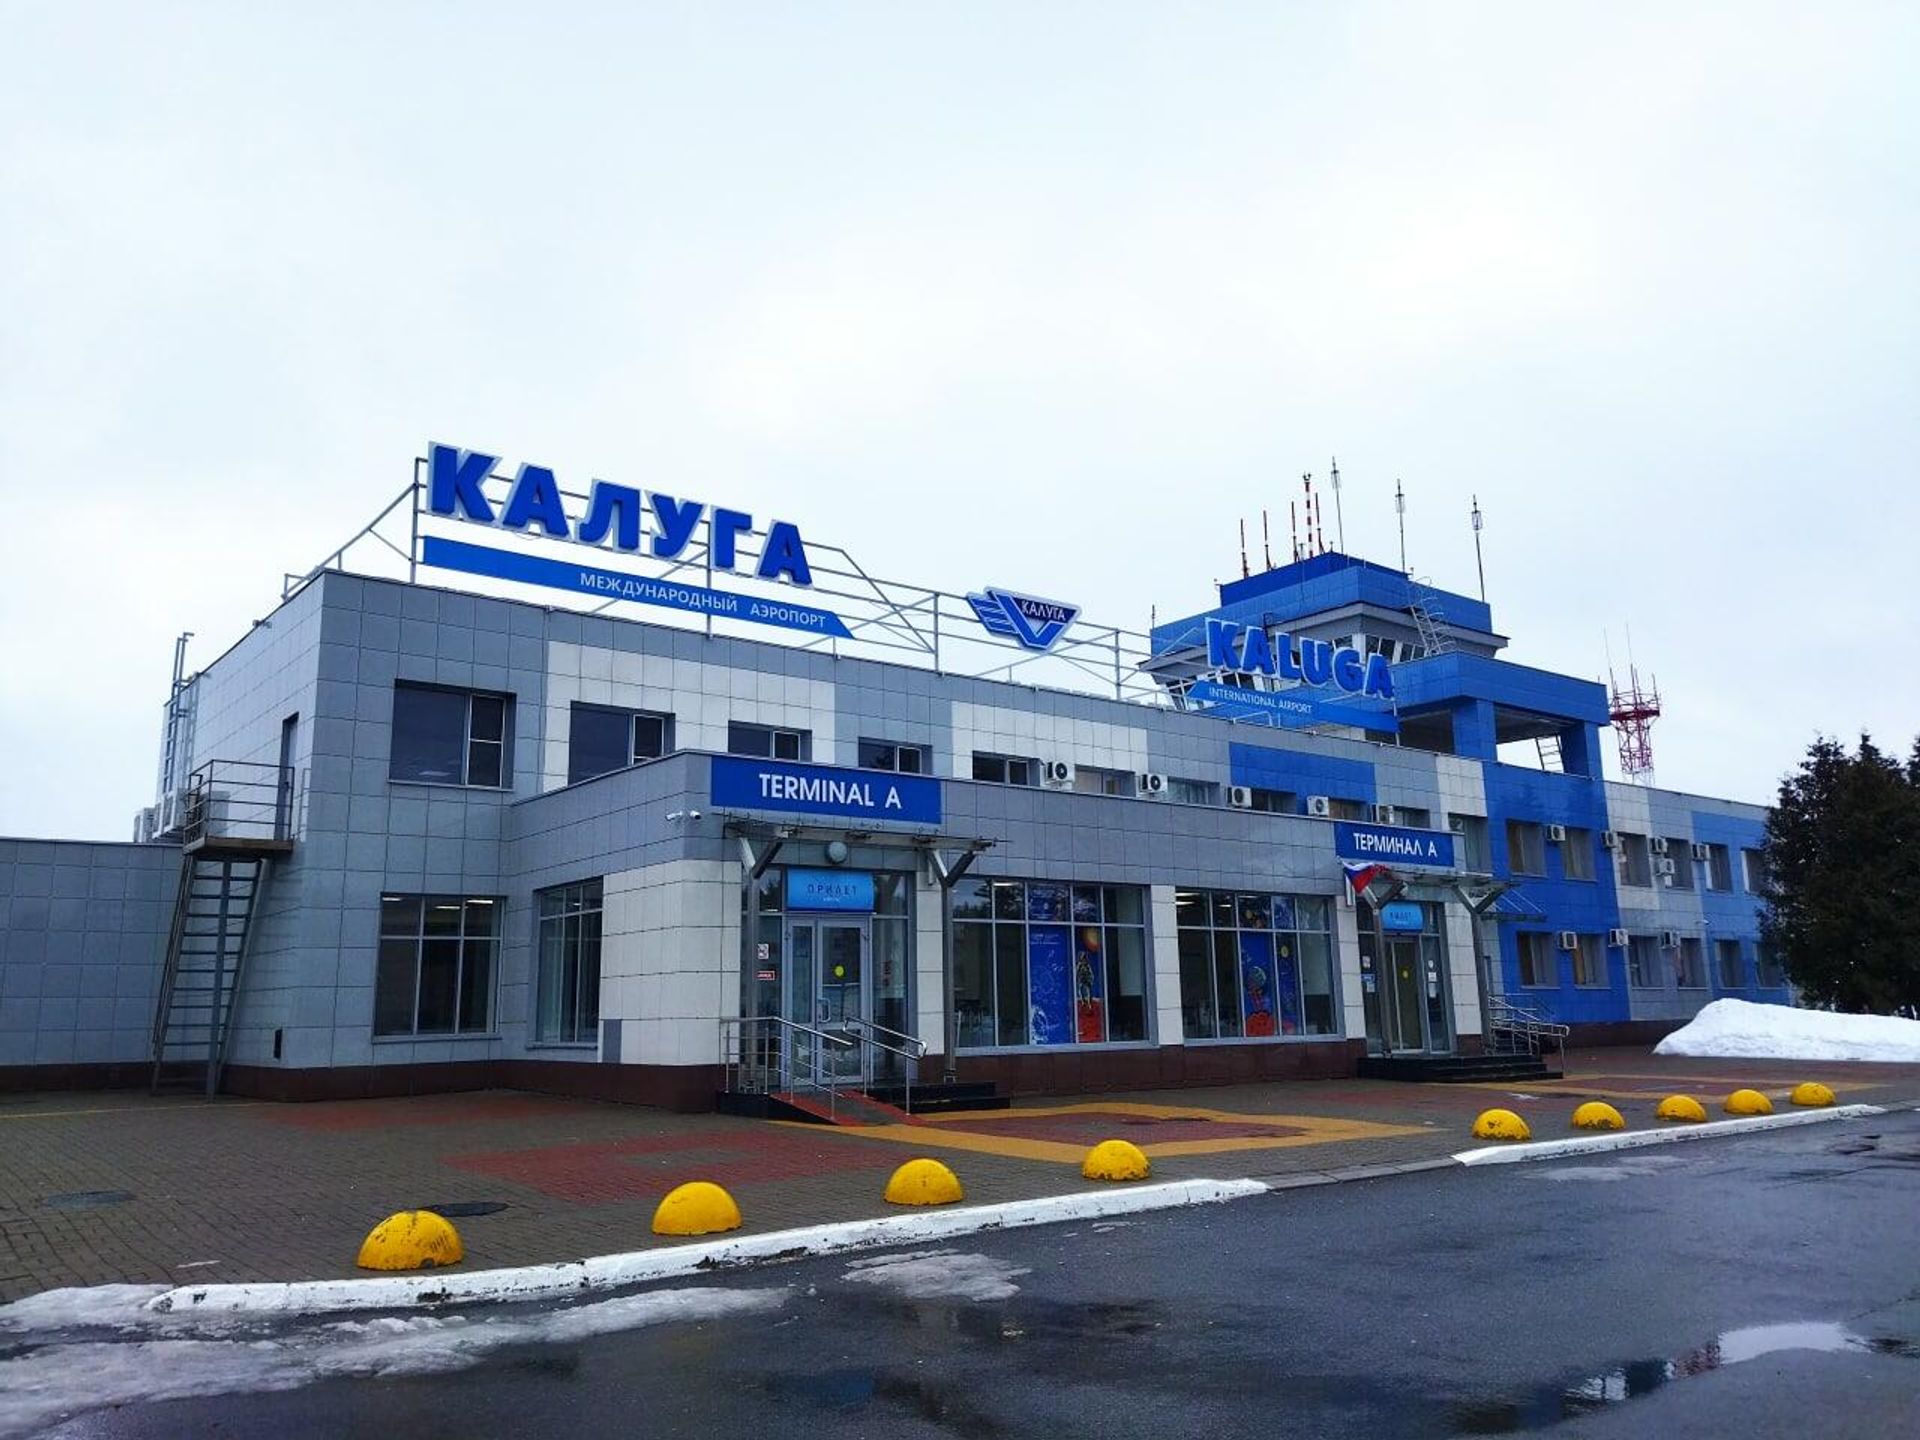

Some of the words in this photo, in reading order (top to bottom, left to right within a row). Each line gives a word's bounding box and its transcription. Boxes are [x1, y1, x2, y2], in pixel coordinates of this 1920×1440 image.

[427, 441, 813, 588] КАЛУГА
[579, 571, 738, 613] МЕЖДУНАРОДНЫЙ
[749, 602, 827, 629] АЭРОПОРТ
[1021, 600, 1066, 621] КАЛУГА
[1205, 617, 1396, 700] KALUGA
[1208, 686, 1277, 708] INTERNATIONAL
[1279, 700, 1313, 714] AIRPORT
[759, 773, 875, 808] TERMINAL
[884, 786, 902, 809] A
[1353, 832, 1423, 857] ТЕРМИНАЛ
